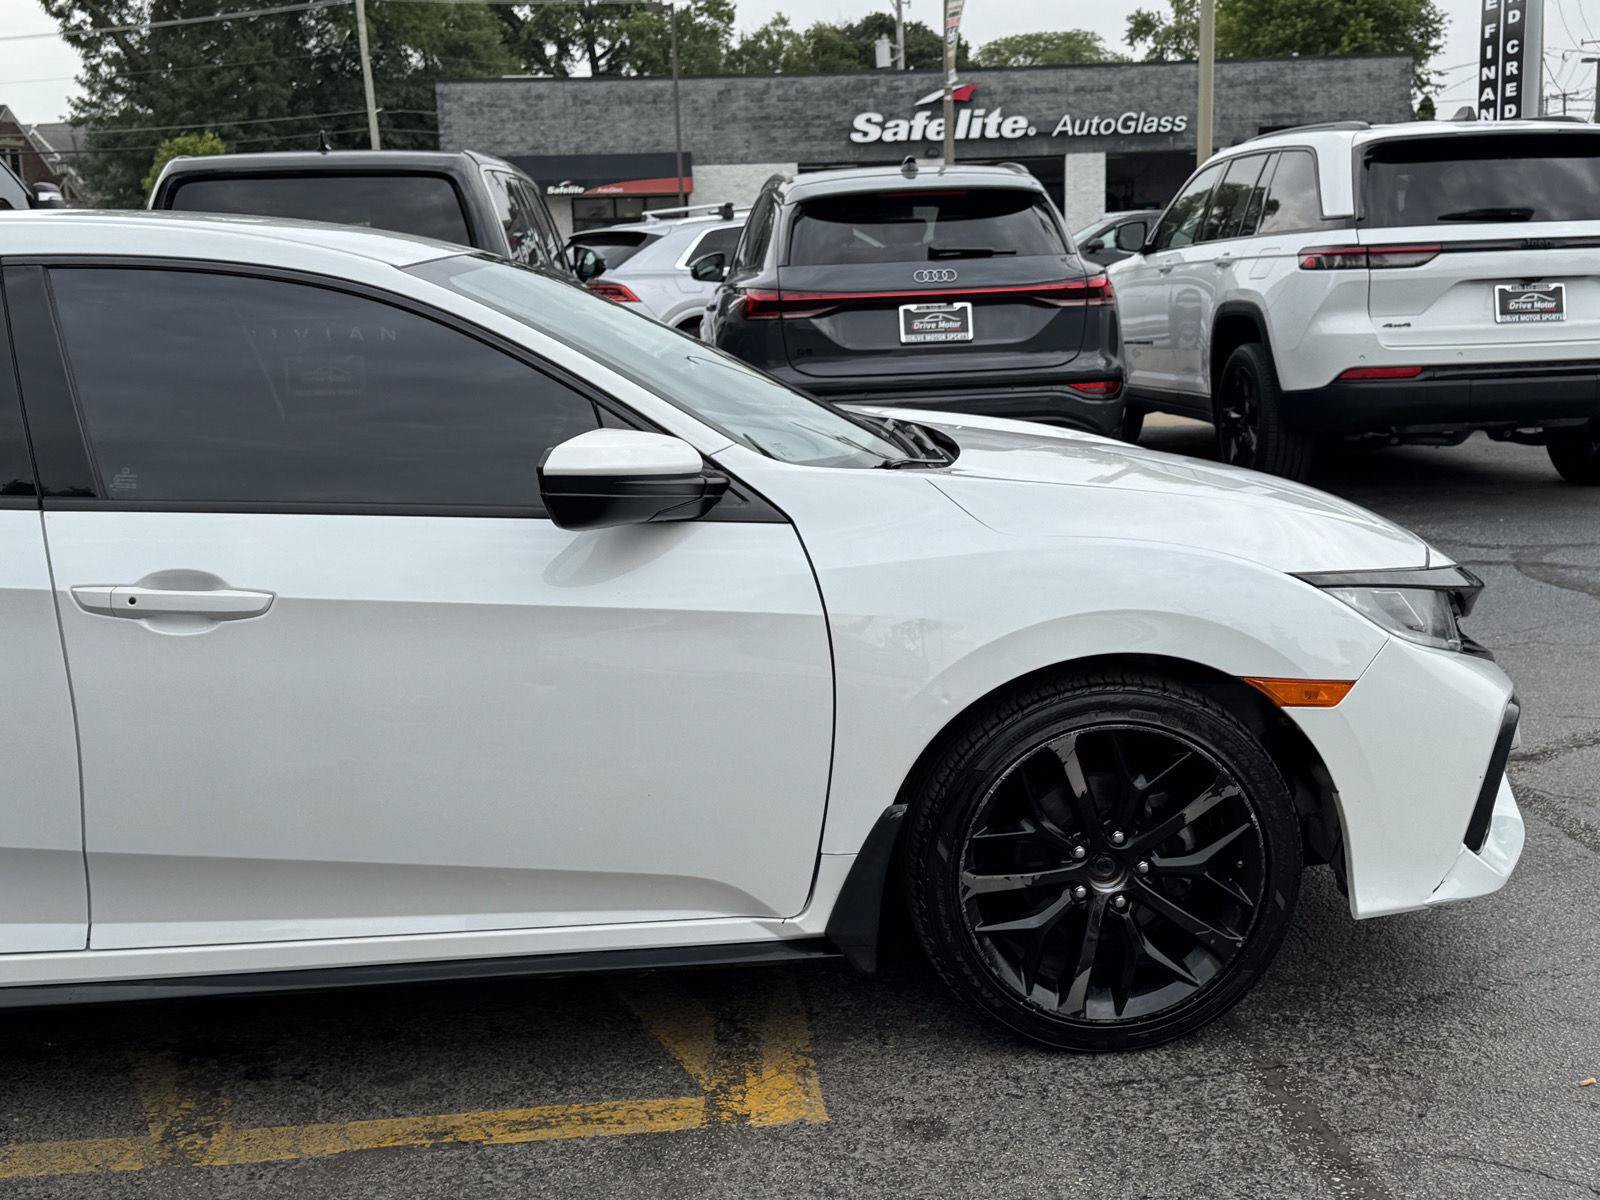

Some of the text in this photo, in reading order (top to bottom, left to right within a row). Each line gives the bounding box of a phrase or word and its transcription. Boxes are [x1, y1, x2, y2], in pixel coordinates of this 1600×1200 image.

[1503, 39, 1520, 119] CRED
[850, 107, 1188, 143] Safelite AutoGlass
[1509, 301, 1556, 310] Drive Motor
[913, 322, 937, 330] Drive
